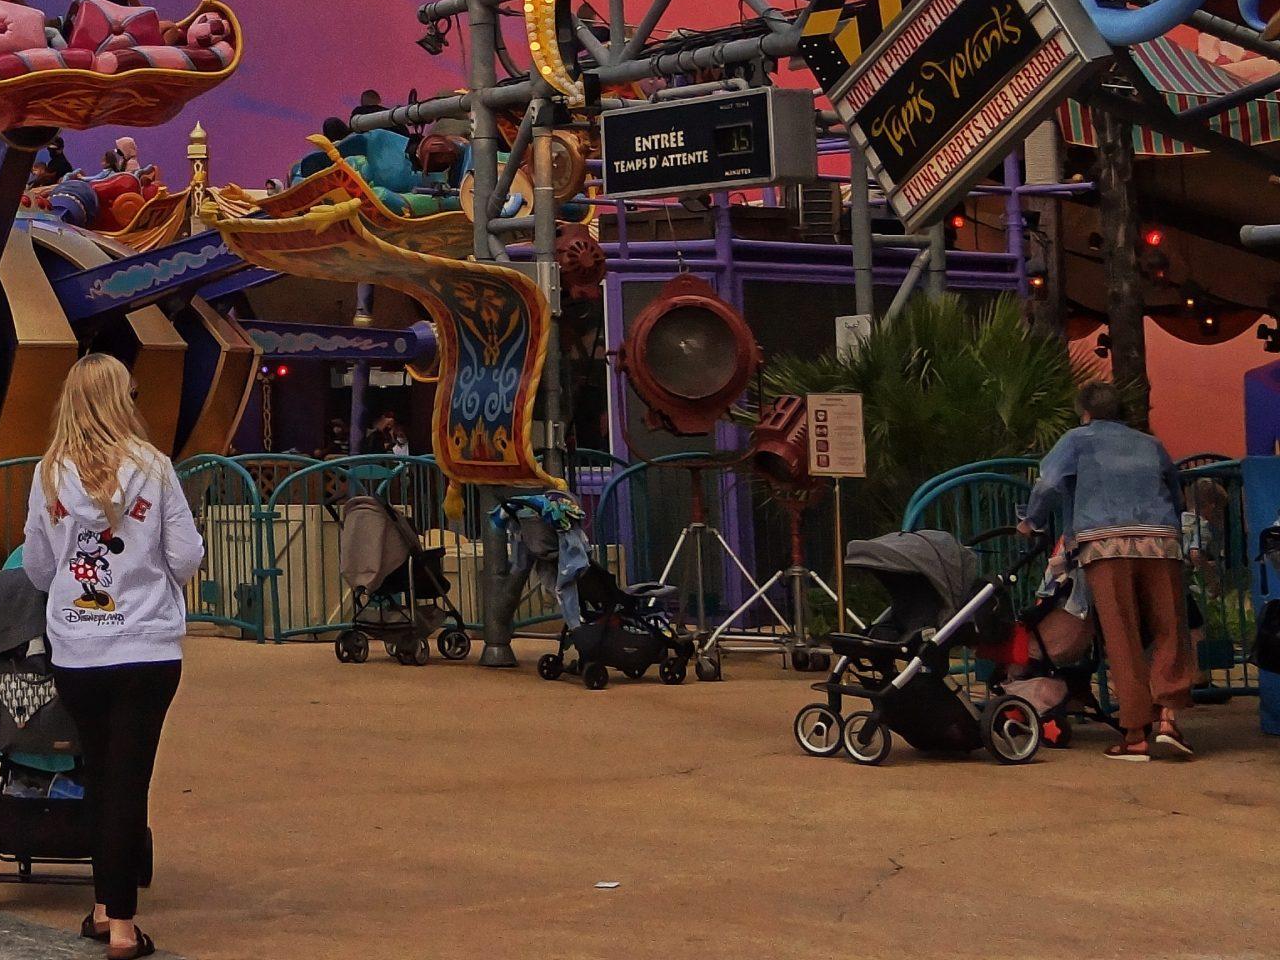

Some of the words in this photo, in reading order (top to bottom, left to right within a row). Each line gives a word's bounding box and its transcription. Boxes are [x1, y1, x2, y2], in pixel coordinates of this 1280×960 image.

[845, 72, 877, 113] NOW
[870, 60, 890, 86] IN
[871, 81, 936, 157] Tapis
[921, 4, 1022, 99] Volants
[634, 126, 686, 153] ENTRÉE
[902, 163, 941, 207] FLYING
[935, 118, 987, 175] CARPETS
[980, 90, 1015, 130] OVER
[1008, 37, 1066, 102] AGRABAH
[613, 156, 648, 174] TEMPS
[661, 149, 710, 169] ATTENTE
